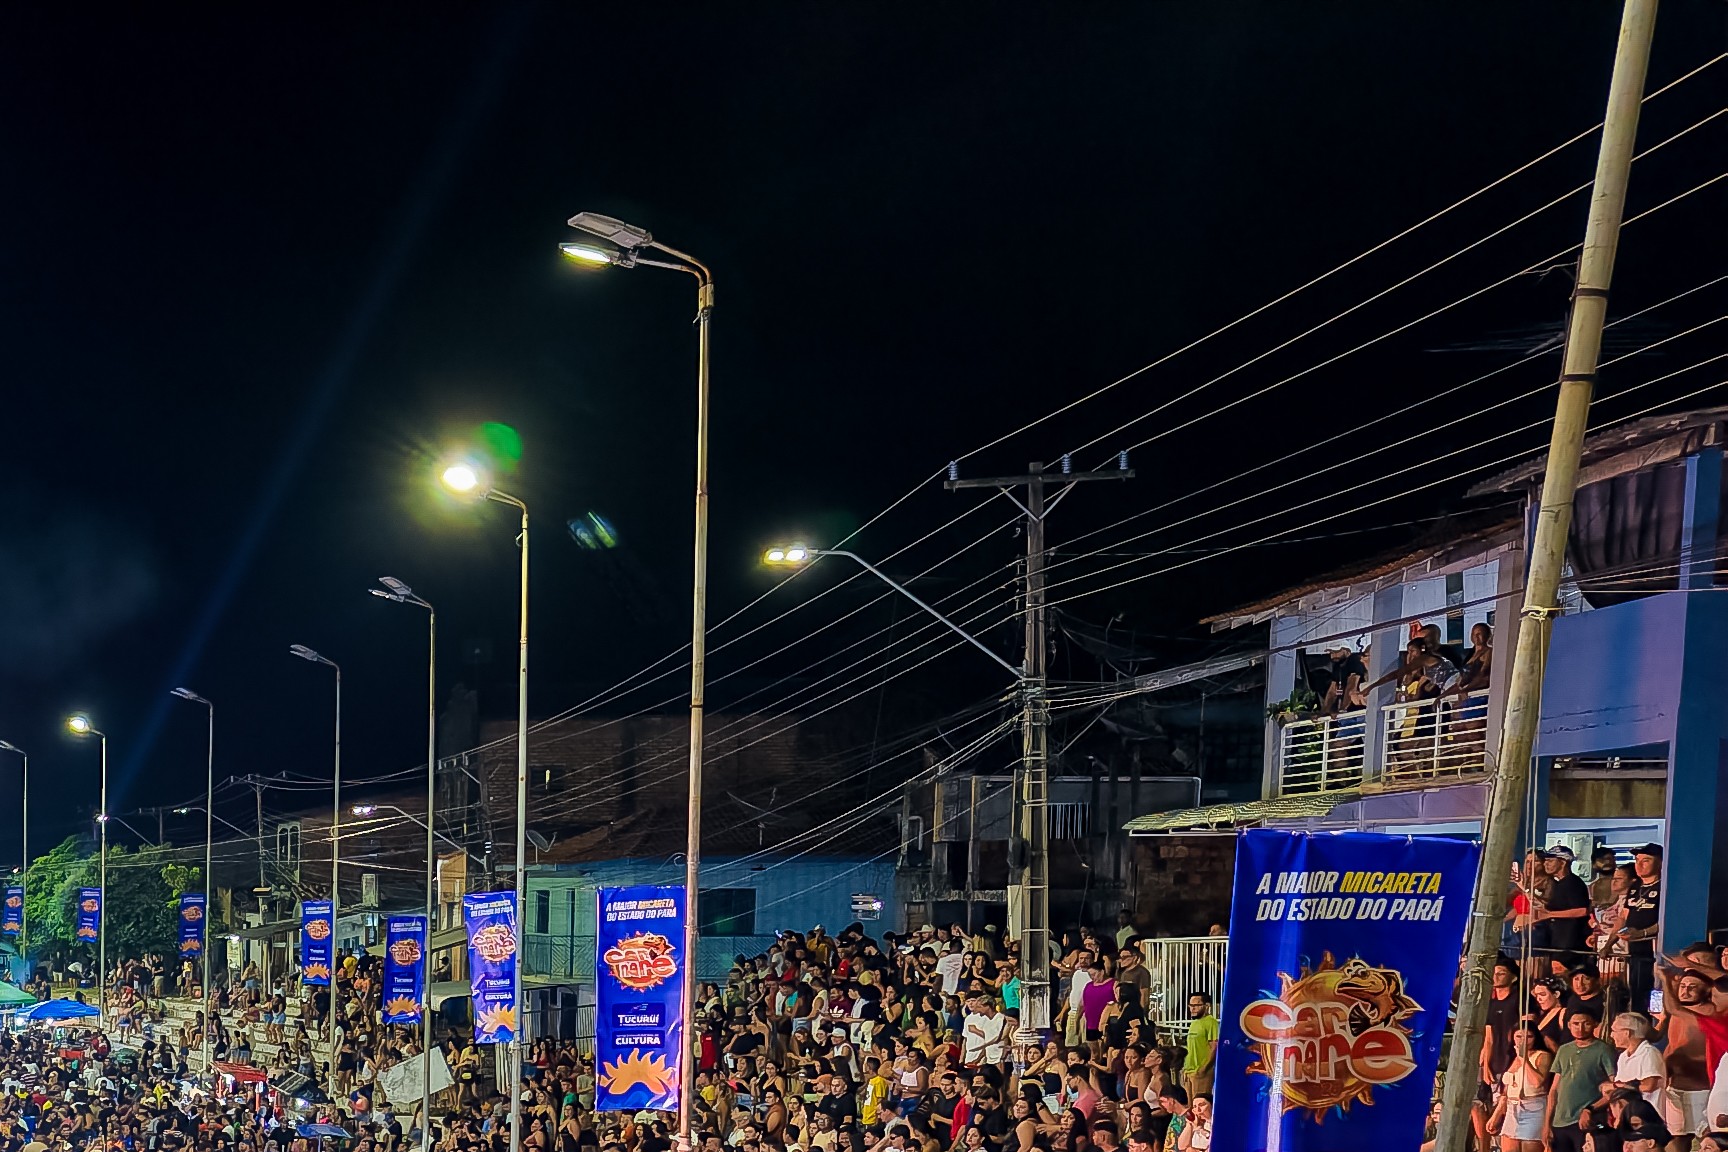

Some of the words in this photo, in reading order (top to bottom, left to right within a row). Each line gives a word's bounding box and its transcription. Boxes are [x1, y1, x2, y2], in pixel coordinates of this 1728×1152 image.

[1256, 872, 1272, 894] A
[1274, 870, 1340, 894] MAIOR
[1339, 871, 1442, 894] MICARETA
[1256, 898, 1285, 921] DO
[1286, 897, 1356, 921] ESTADO
[1356, 897, 1388, 920] DO
[1387, 895, 1446, 921] PARÁ
[615, 1036, 661, 1045] CULTURA
